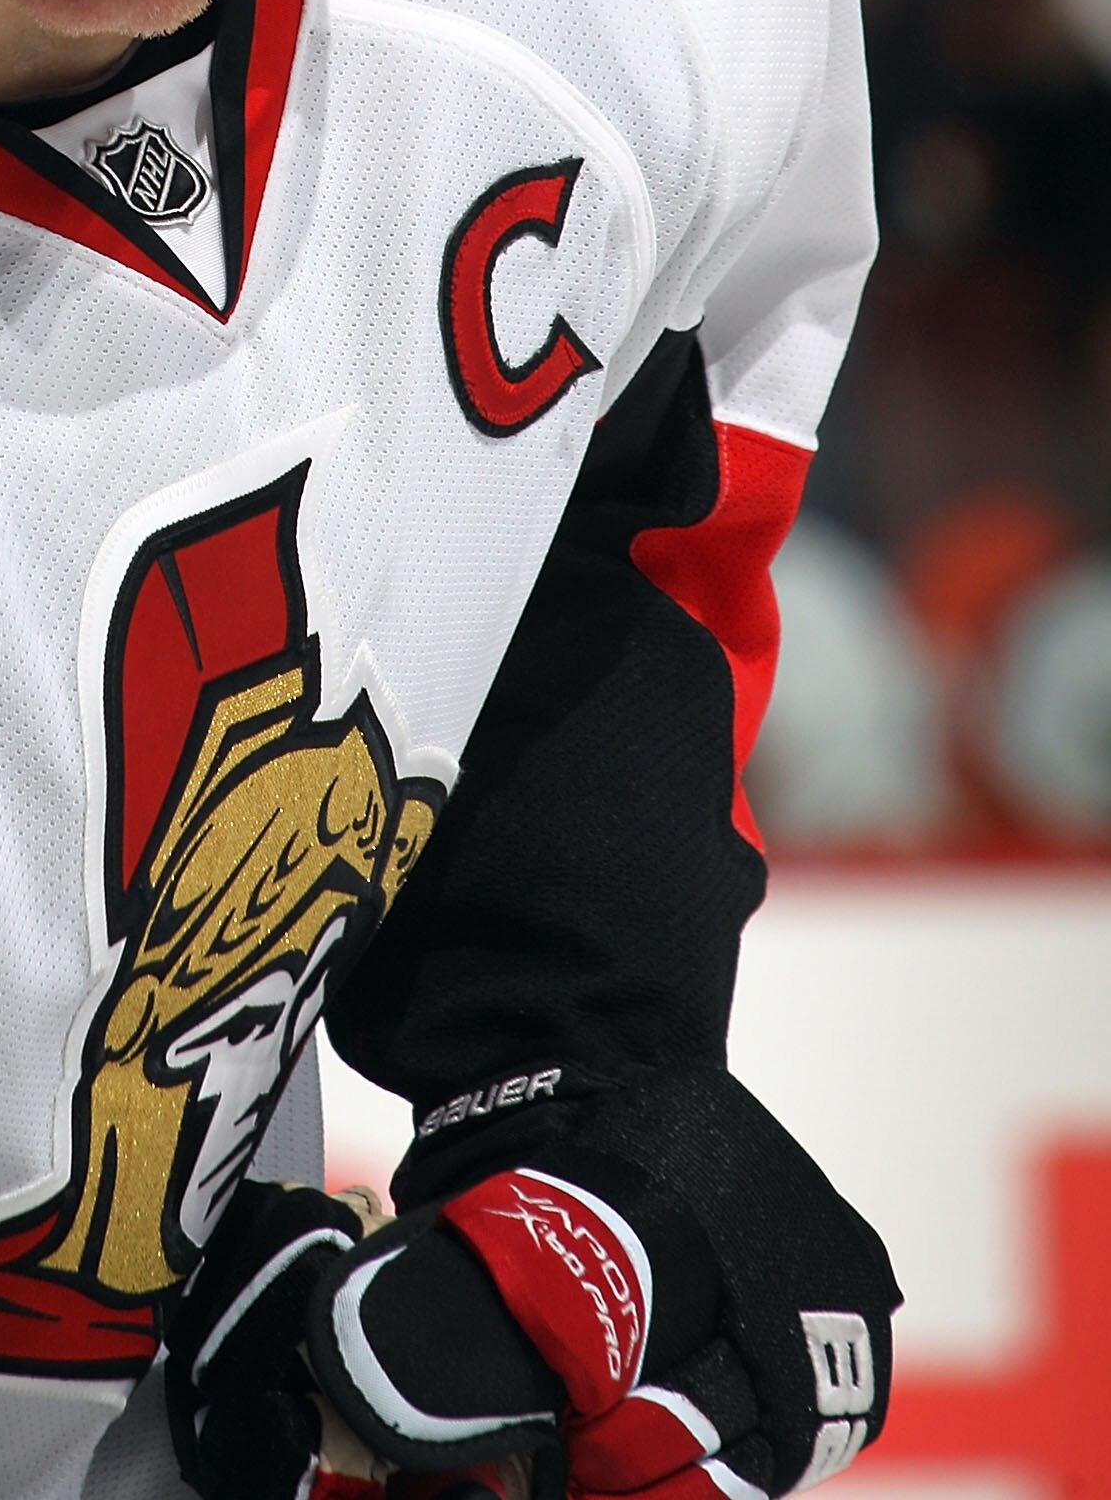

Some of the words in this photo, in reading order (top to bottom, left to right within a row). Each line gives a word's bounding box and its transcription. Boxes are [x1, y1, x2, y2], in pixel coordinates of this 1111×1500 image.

[133, 144, 171, 212] NHL
[437, 155, 604, 439] C
[508, 1183, 640, 1369] VAPOR
[580, 1280, 622, 1382] PRO
